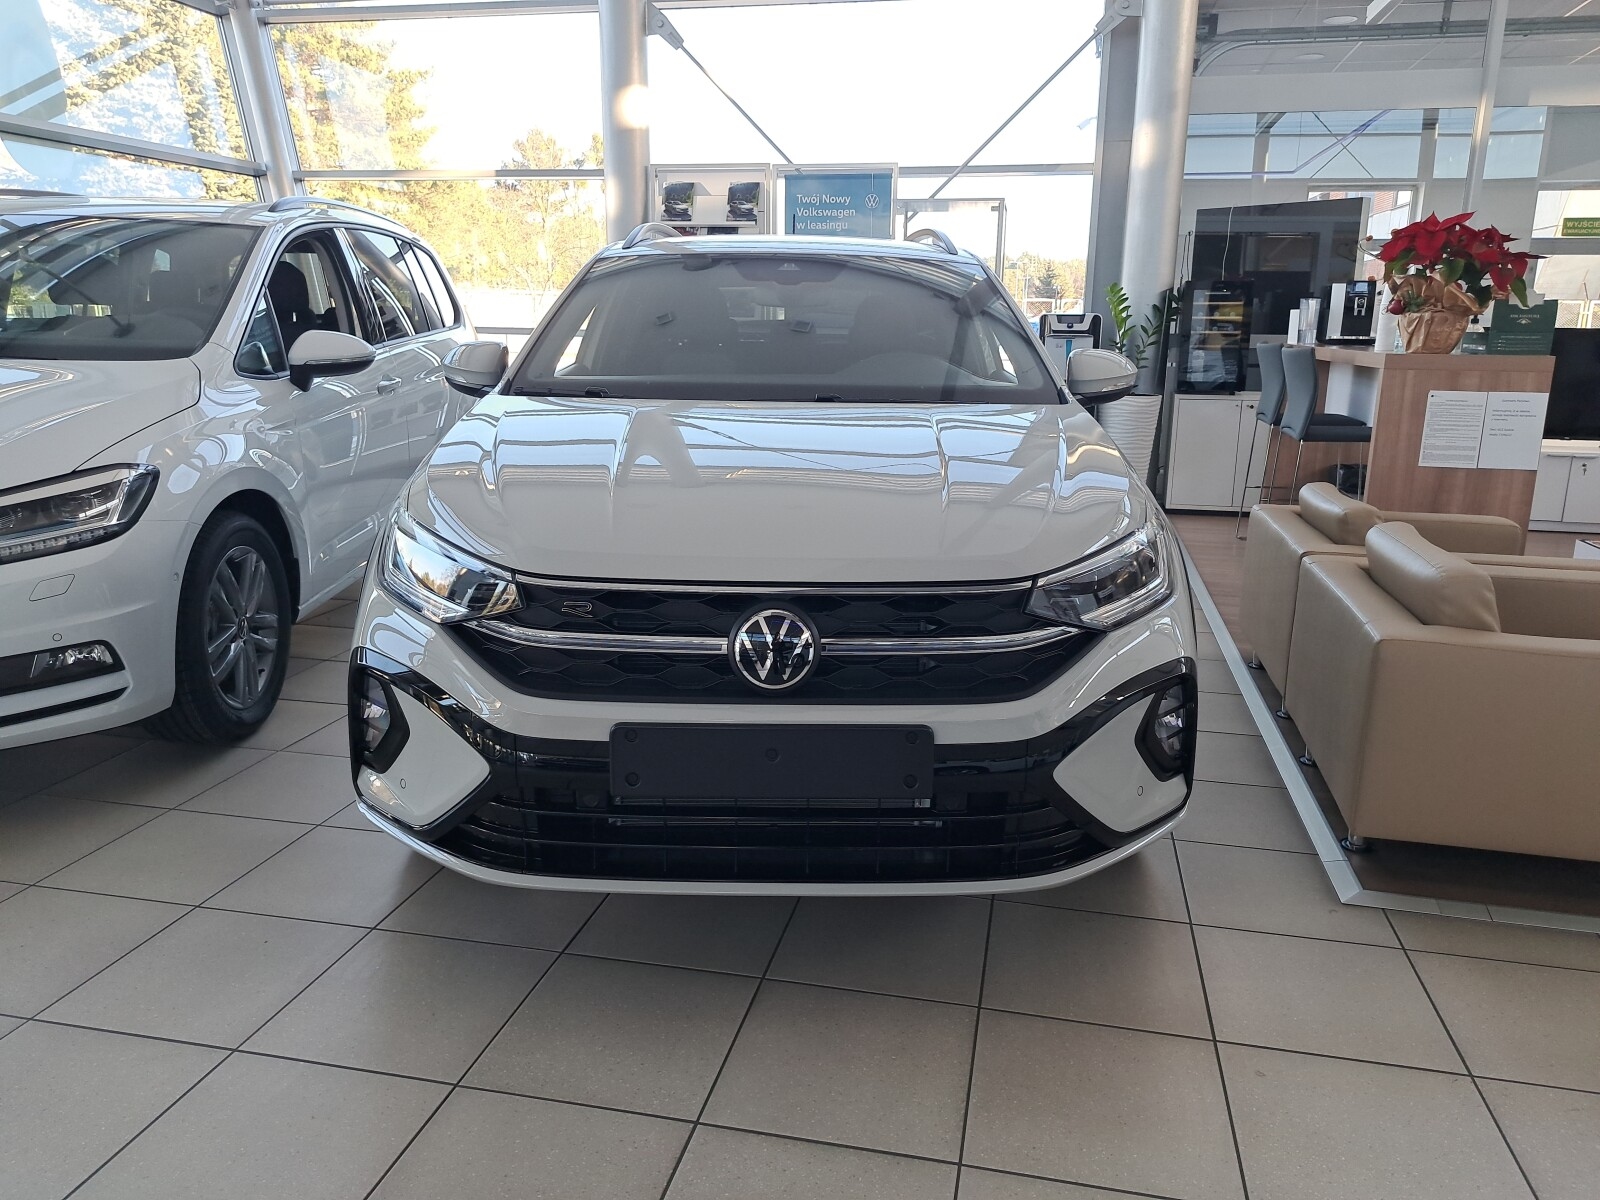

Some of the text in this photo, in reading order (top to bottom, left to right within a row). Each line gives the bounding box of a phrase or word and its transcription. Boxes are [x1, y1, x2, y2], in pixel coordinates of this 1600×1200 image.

[796, 194, 851, 206] Twój Nowy
[796, 208, 856, 219] Volkswagen
[796, 220, 848, 231] w leasingu
[1566, 220, 1600, 228] WYJŚCIE
